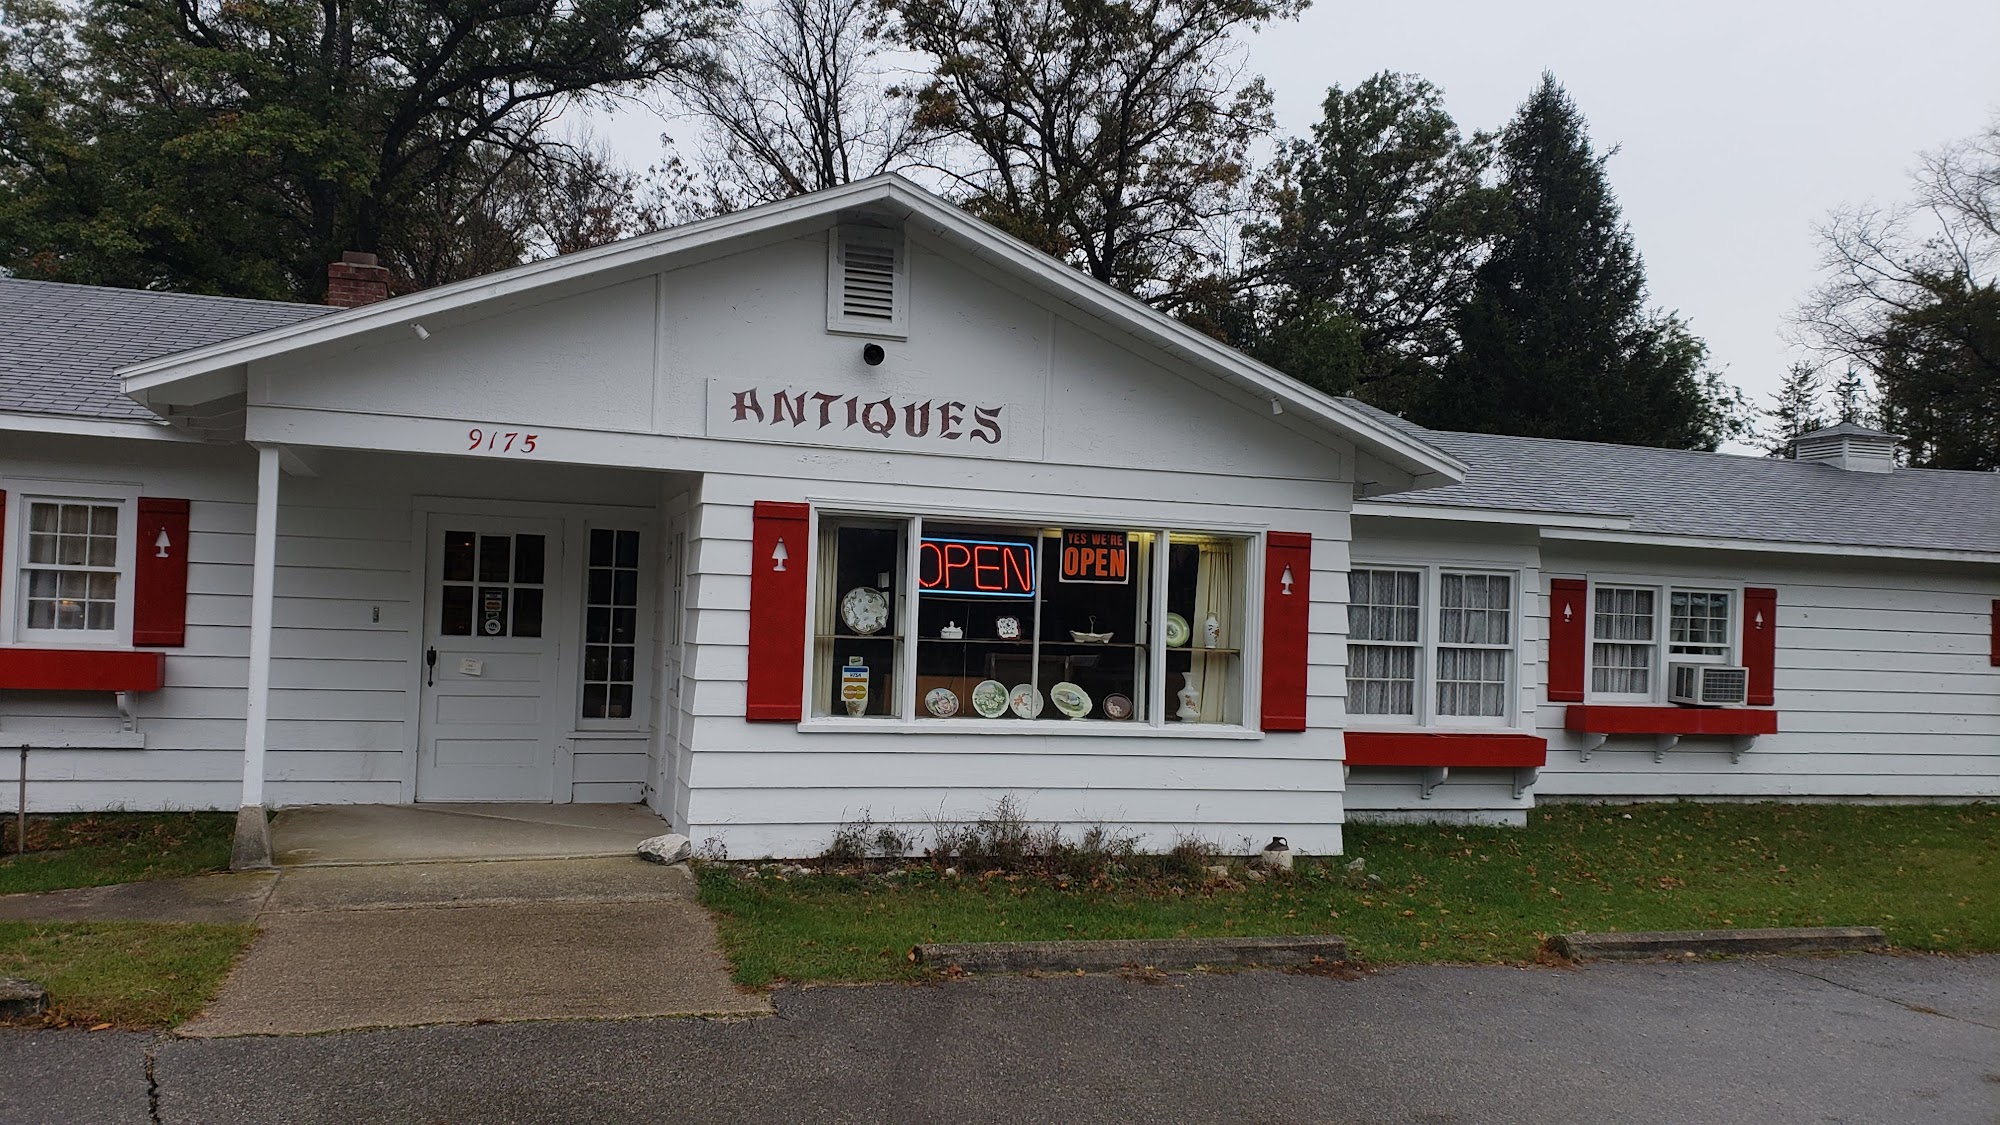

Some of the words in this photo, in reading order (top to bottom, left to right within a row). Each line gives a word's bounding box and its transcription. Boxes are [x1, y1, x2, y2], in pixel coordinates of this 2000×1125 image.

[730, 386, 1006, 445] ANTIQUES
[468, 428, 538, 453] 9175
[1067, 532, 1087, 545] YES
[1091, 533, 1123, 547] WE'RE
[919, 543, 1030, 592] OPEN
[1064, 546, 1126, 577] OPEN
